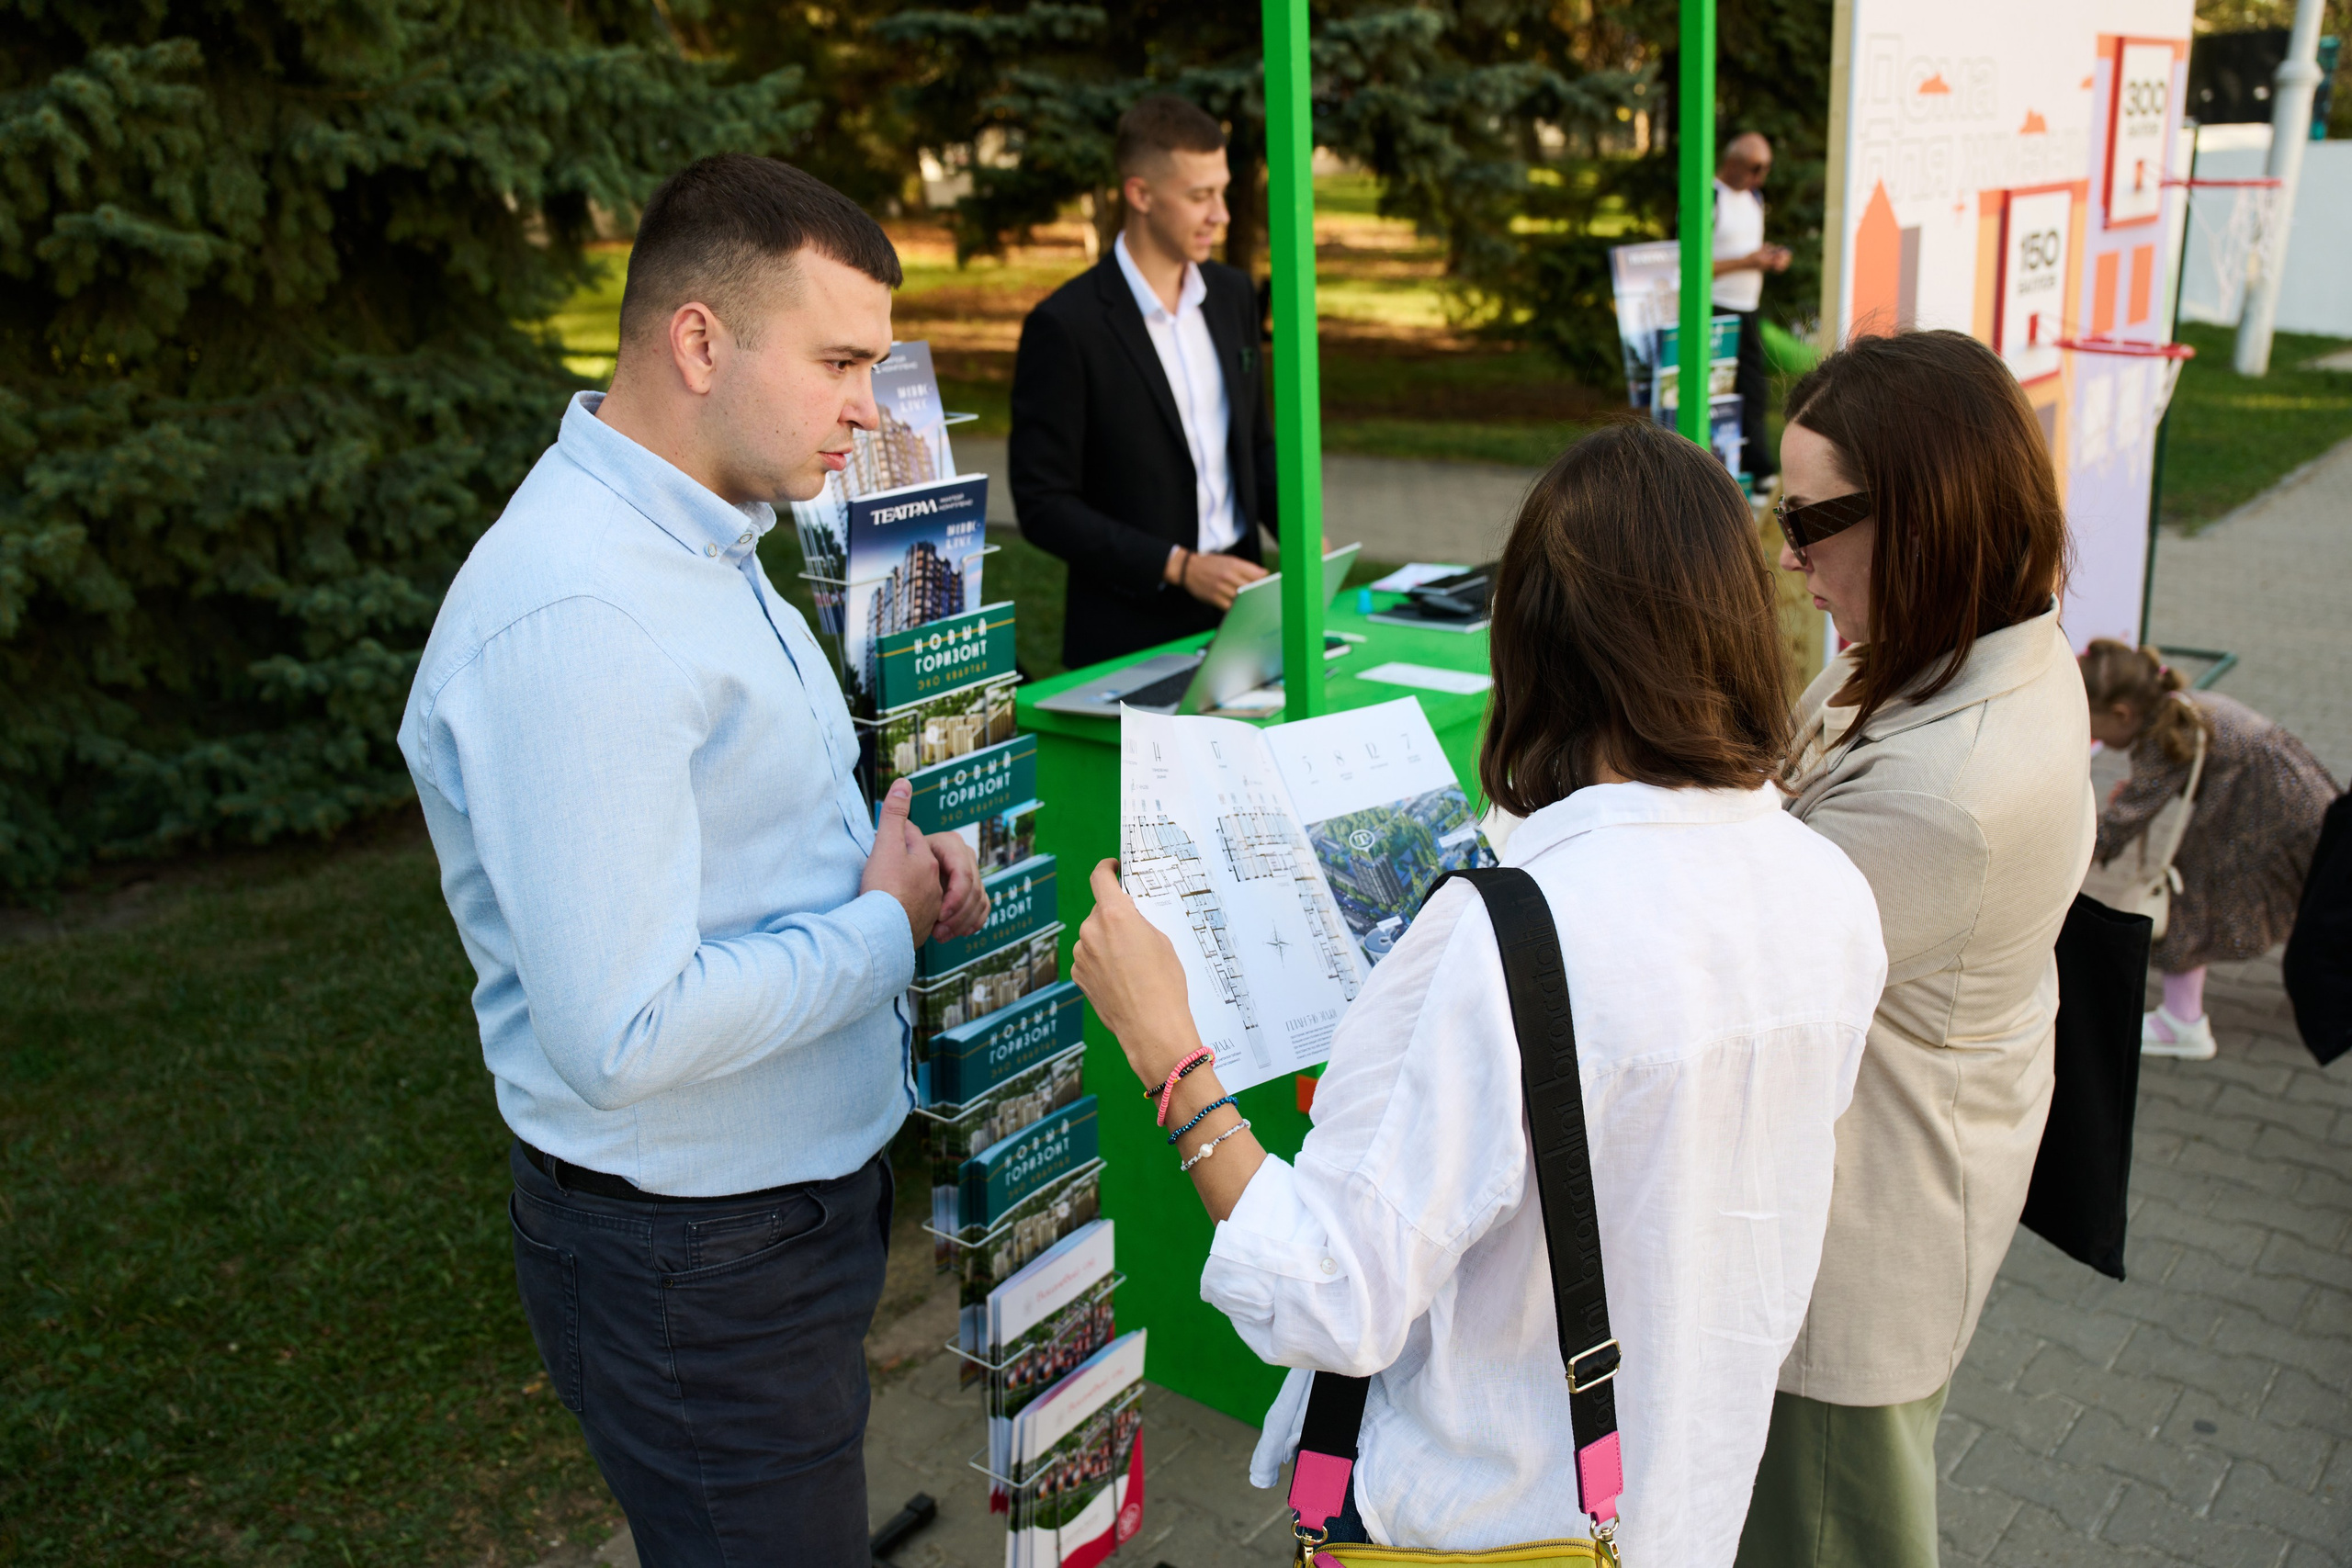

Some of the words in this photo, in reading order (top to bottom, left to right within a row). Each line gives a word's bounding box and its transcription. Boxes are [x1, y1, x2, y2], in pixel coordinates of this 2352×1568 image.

[2124, 80, 2166, 117] 300
[2019, 227, 2060, 273] 150
[913, 617, 987, 655] НОВЫЙ
[915, 639, 987, 674] ГОРИЗОНТ
[939, 750, 1011, 791] НОВЫЙ
[939, 772, 1011, 810] ГОРИЗОНТ
[994, 875, 1032, 907] ВЫЙ
[975, 896, 1032, 935] РИЗОНТ
[989, 1000, 1057, 1046] НОВЫЙ
[989, 1019, 1057, 1065] ГОРИЗОНТ
[1004, 1136, 1070, 1187] ГОРИЗОНТ
